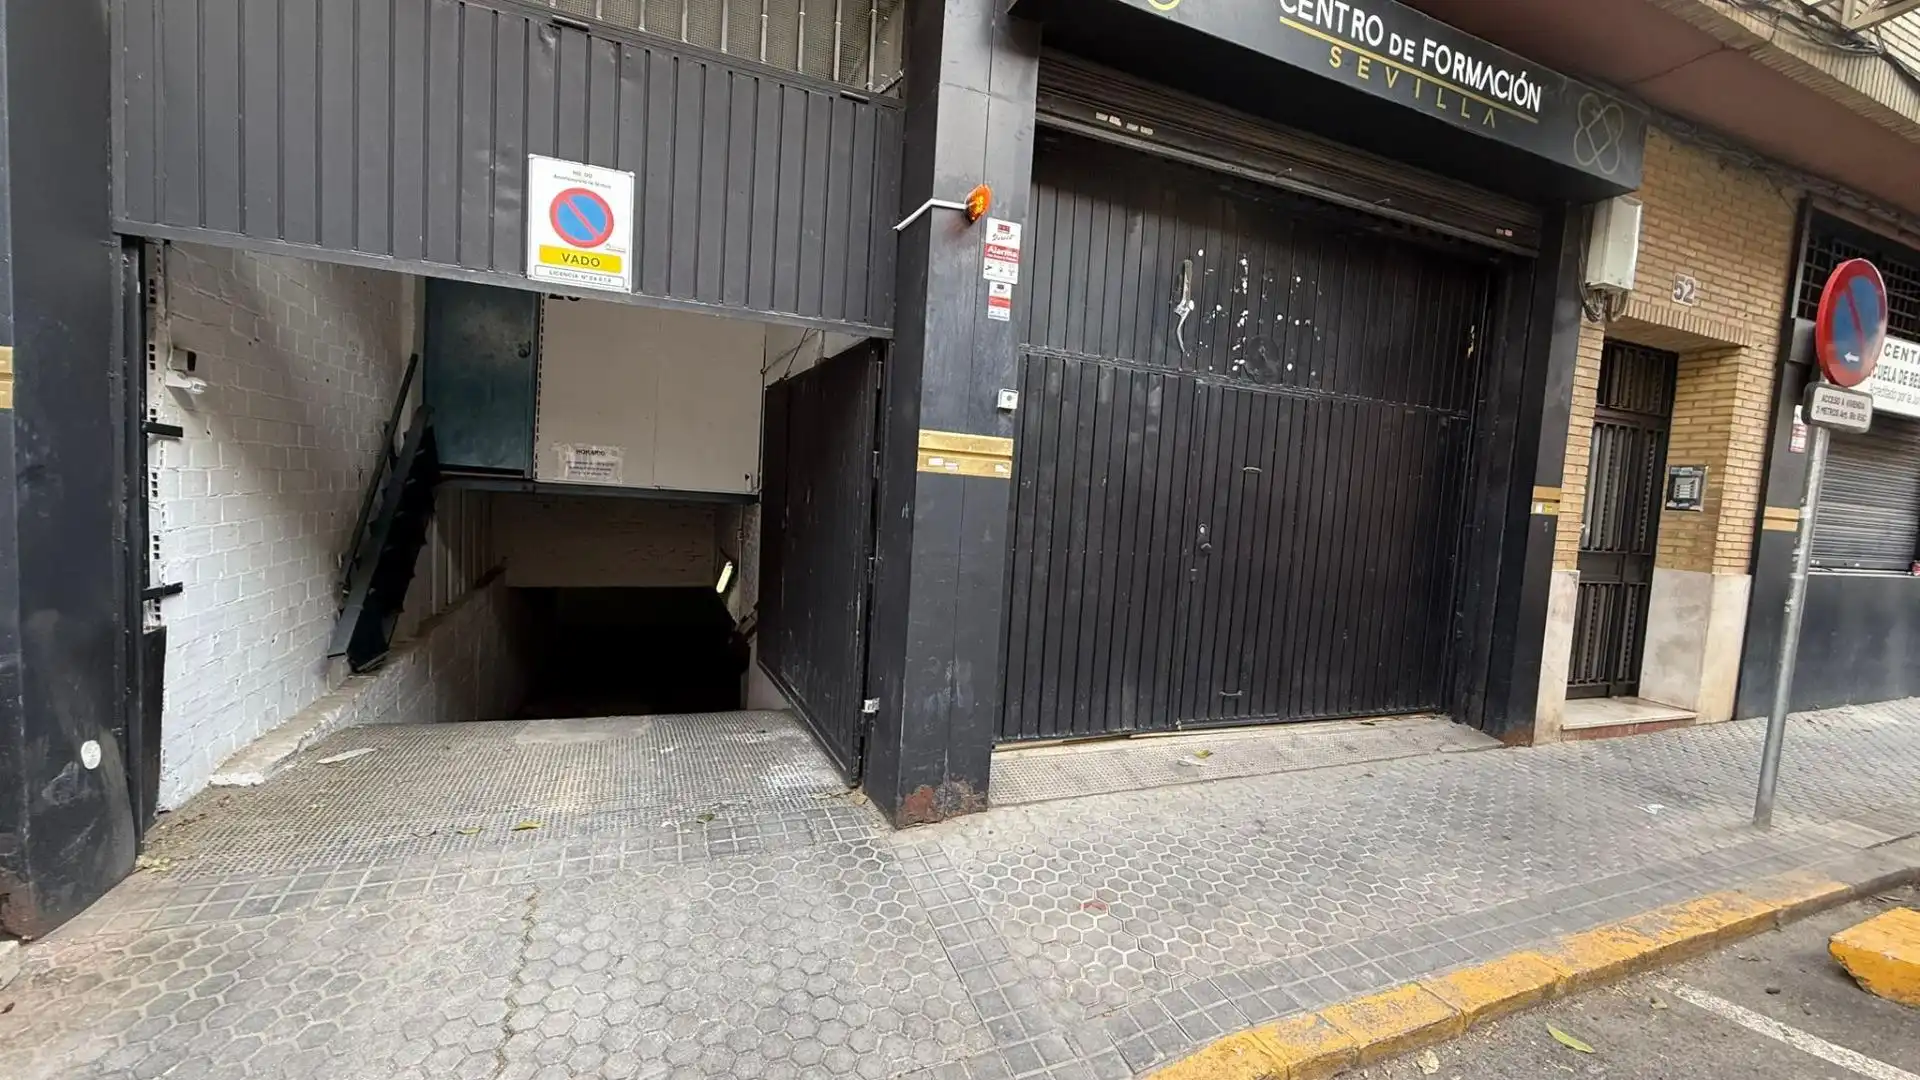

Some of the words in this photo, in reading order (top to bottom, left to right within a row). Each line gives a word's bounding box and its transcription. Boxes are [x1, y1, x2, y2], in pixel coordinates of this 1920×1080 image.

[1389, 32, 1416, 62] DE
[1421, 38, 1542, 113] FORMACIÓN
[1328, 45, 1496, 129] SEVILLA
[561, 252, 600, 268] VADO
[548, 269, 579, 280] LICENCIA
[1673, 276, 1694, 304] 52
[1883, 343, 1920, 365] CENT
